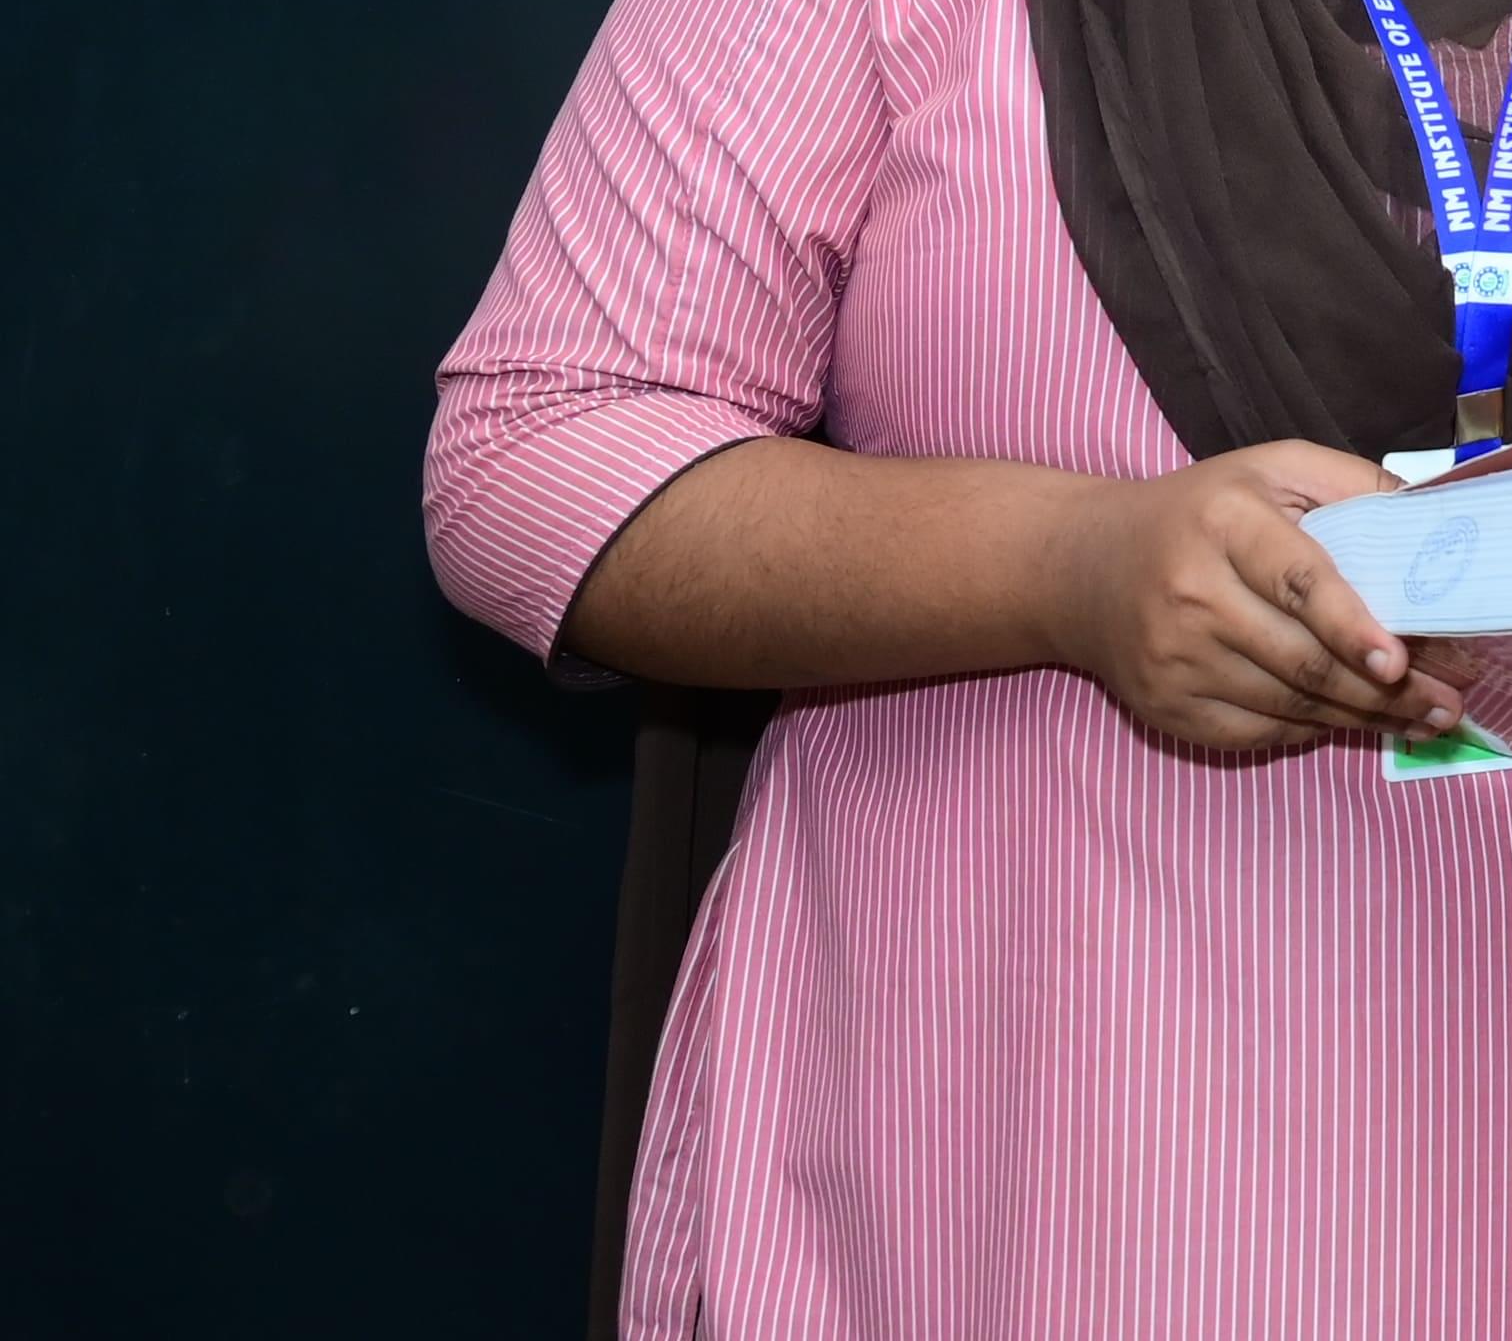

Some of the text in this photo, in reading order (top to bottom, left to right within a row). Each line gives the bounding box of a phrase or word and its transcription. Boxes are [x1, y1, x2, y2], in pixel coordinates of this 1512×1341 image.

[1380, 17, 1476, 234] NM INSTITUTE OF
